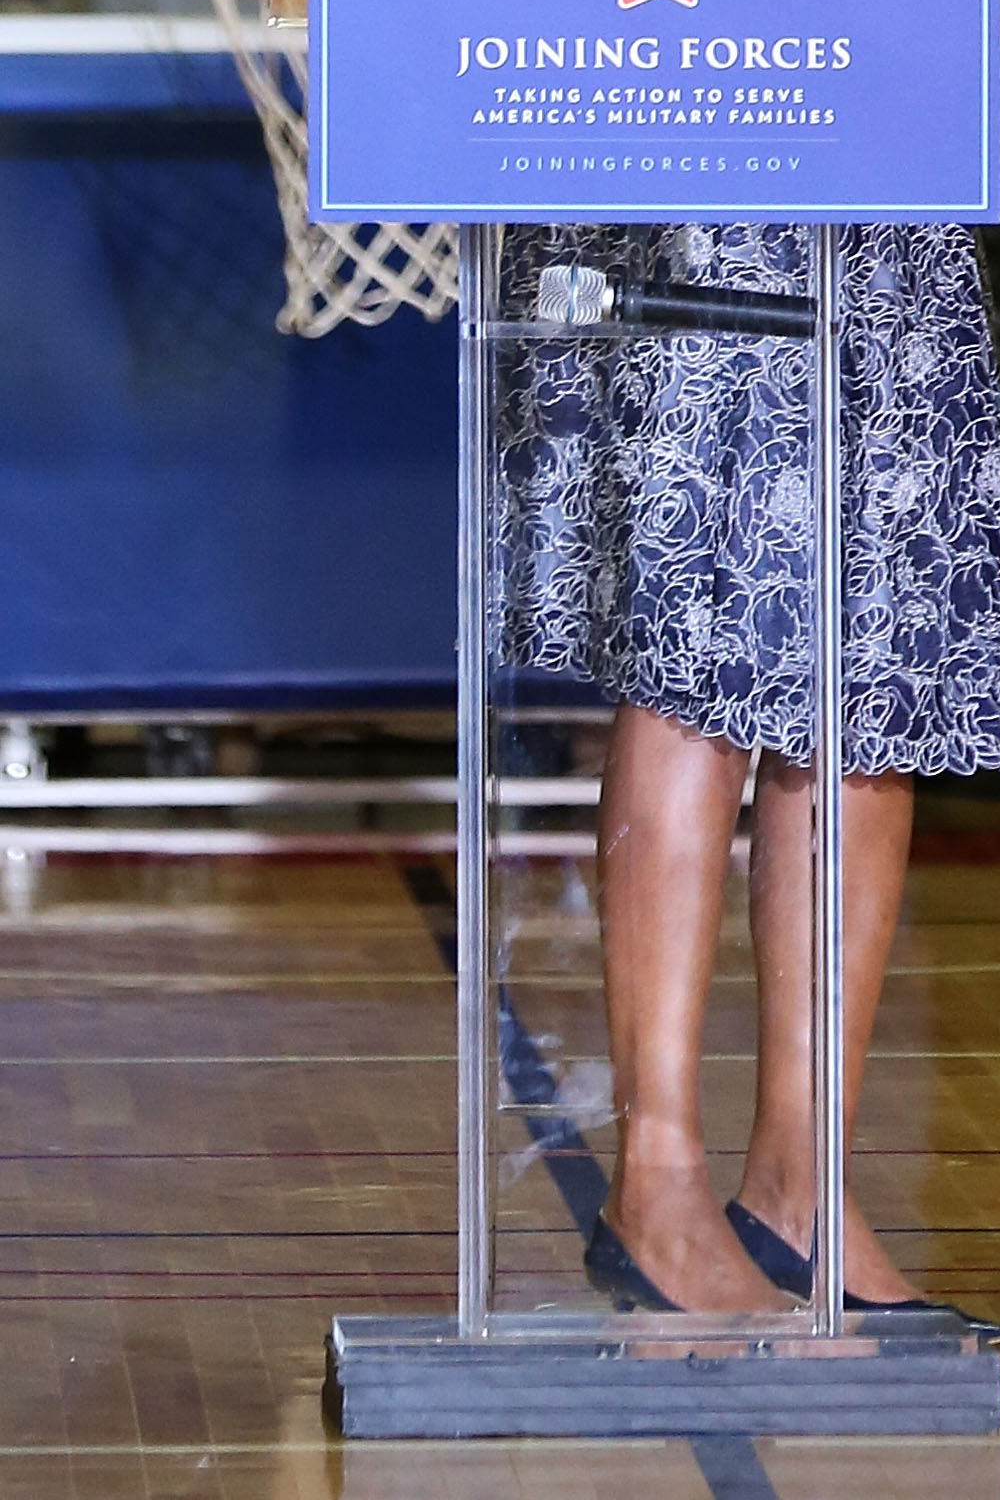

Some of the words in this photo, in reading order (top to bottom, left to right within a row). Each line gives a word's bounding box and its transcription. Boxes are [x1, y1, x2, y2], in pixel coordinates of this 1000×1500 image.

[456, 36, 660, 77] JOINING
[679, 36, 852, 70] FORCES
[494, 87, 582, 104] TAKING
[592, 87, 682, 104] ACTION
[693, 87, 723, 104] TO
[733, 87, 805, 104] SERVE
[472, 108, 597, 125] AMERICA'S
[607, 108, 718, 125] MILITARY
[728, 108, 837, 125] FAMILIES
[499, 156, 802, 172] JOININGFORCES.GOV
